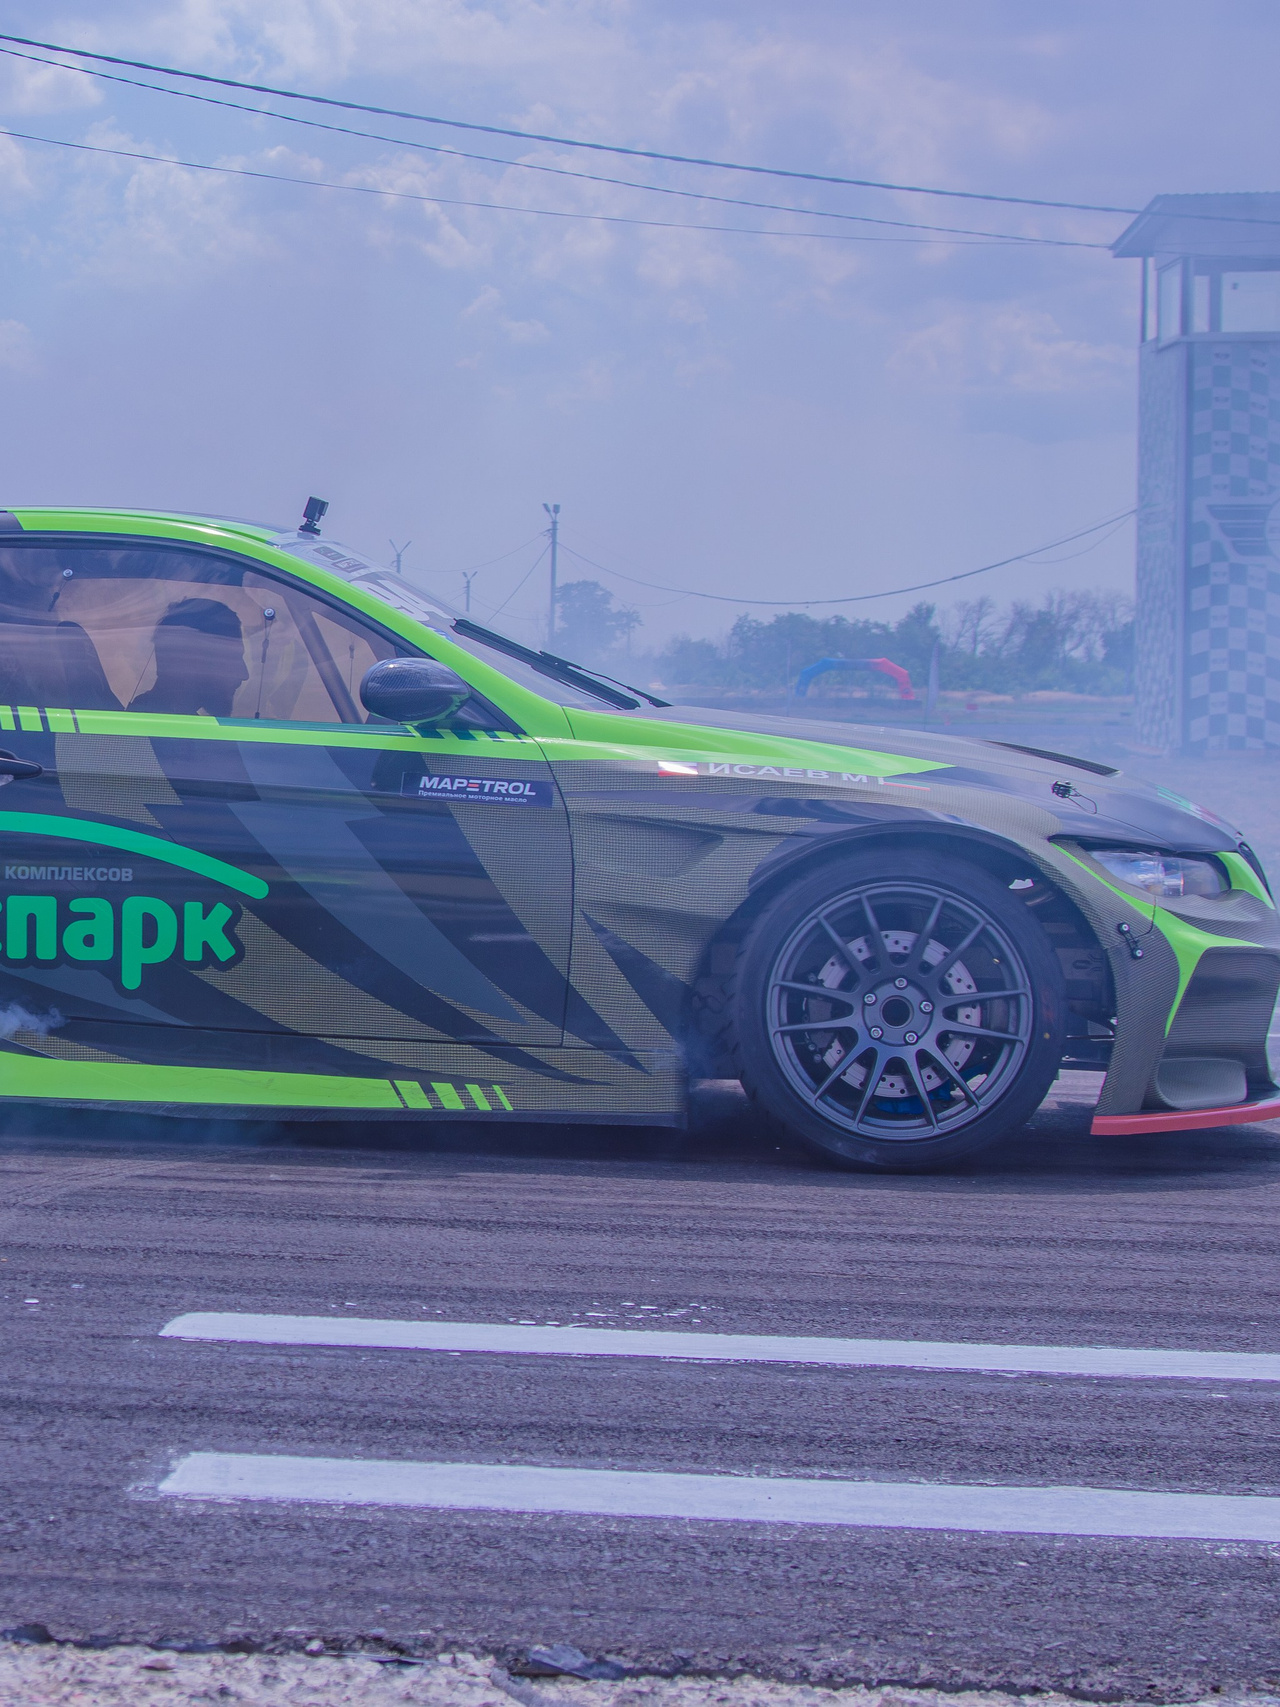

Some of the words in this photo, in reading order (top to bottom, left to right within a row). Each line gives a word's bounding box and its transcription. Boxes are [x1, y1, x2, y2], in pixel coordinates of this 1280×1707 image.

[708, 763, 829, 779] ИСАЕВ
[419, 776, 537, 796] MAPETROL
[419, 790, 467, 799] Премиальное
[468, 794, 503, 802] моторное
[5, 865, 134, 882] КОМПЛЕКСОВ
